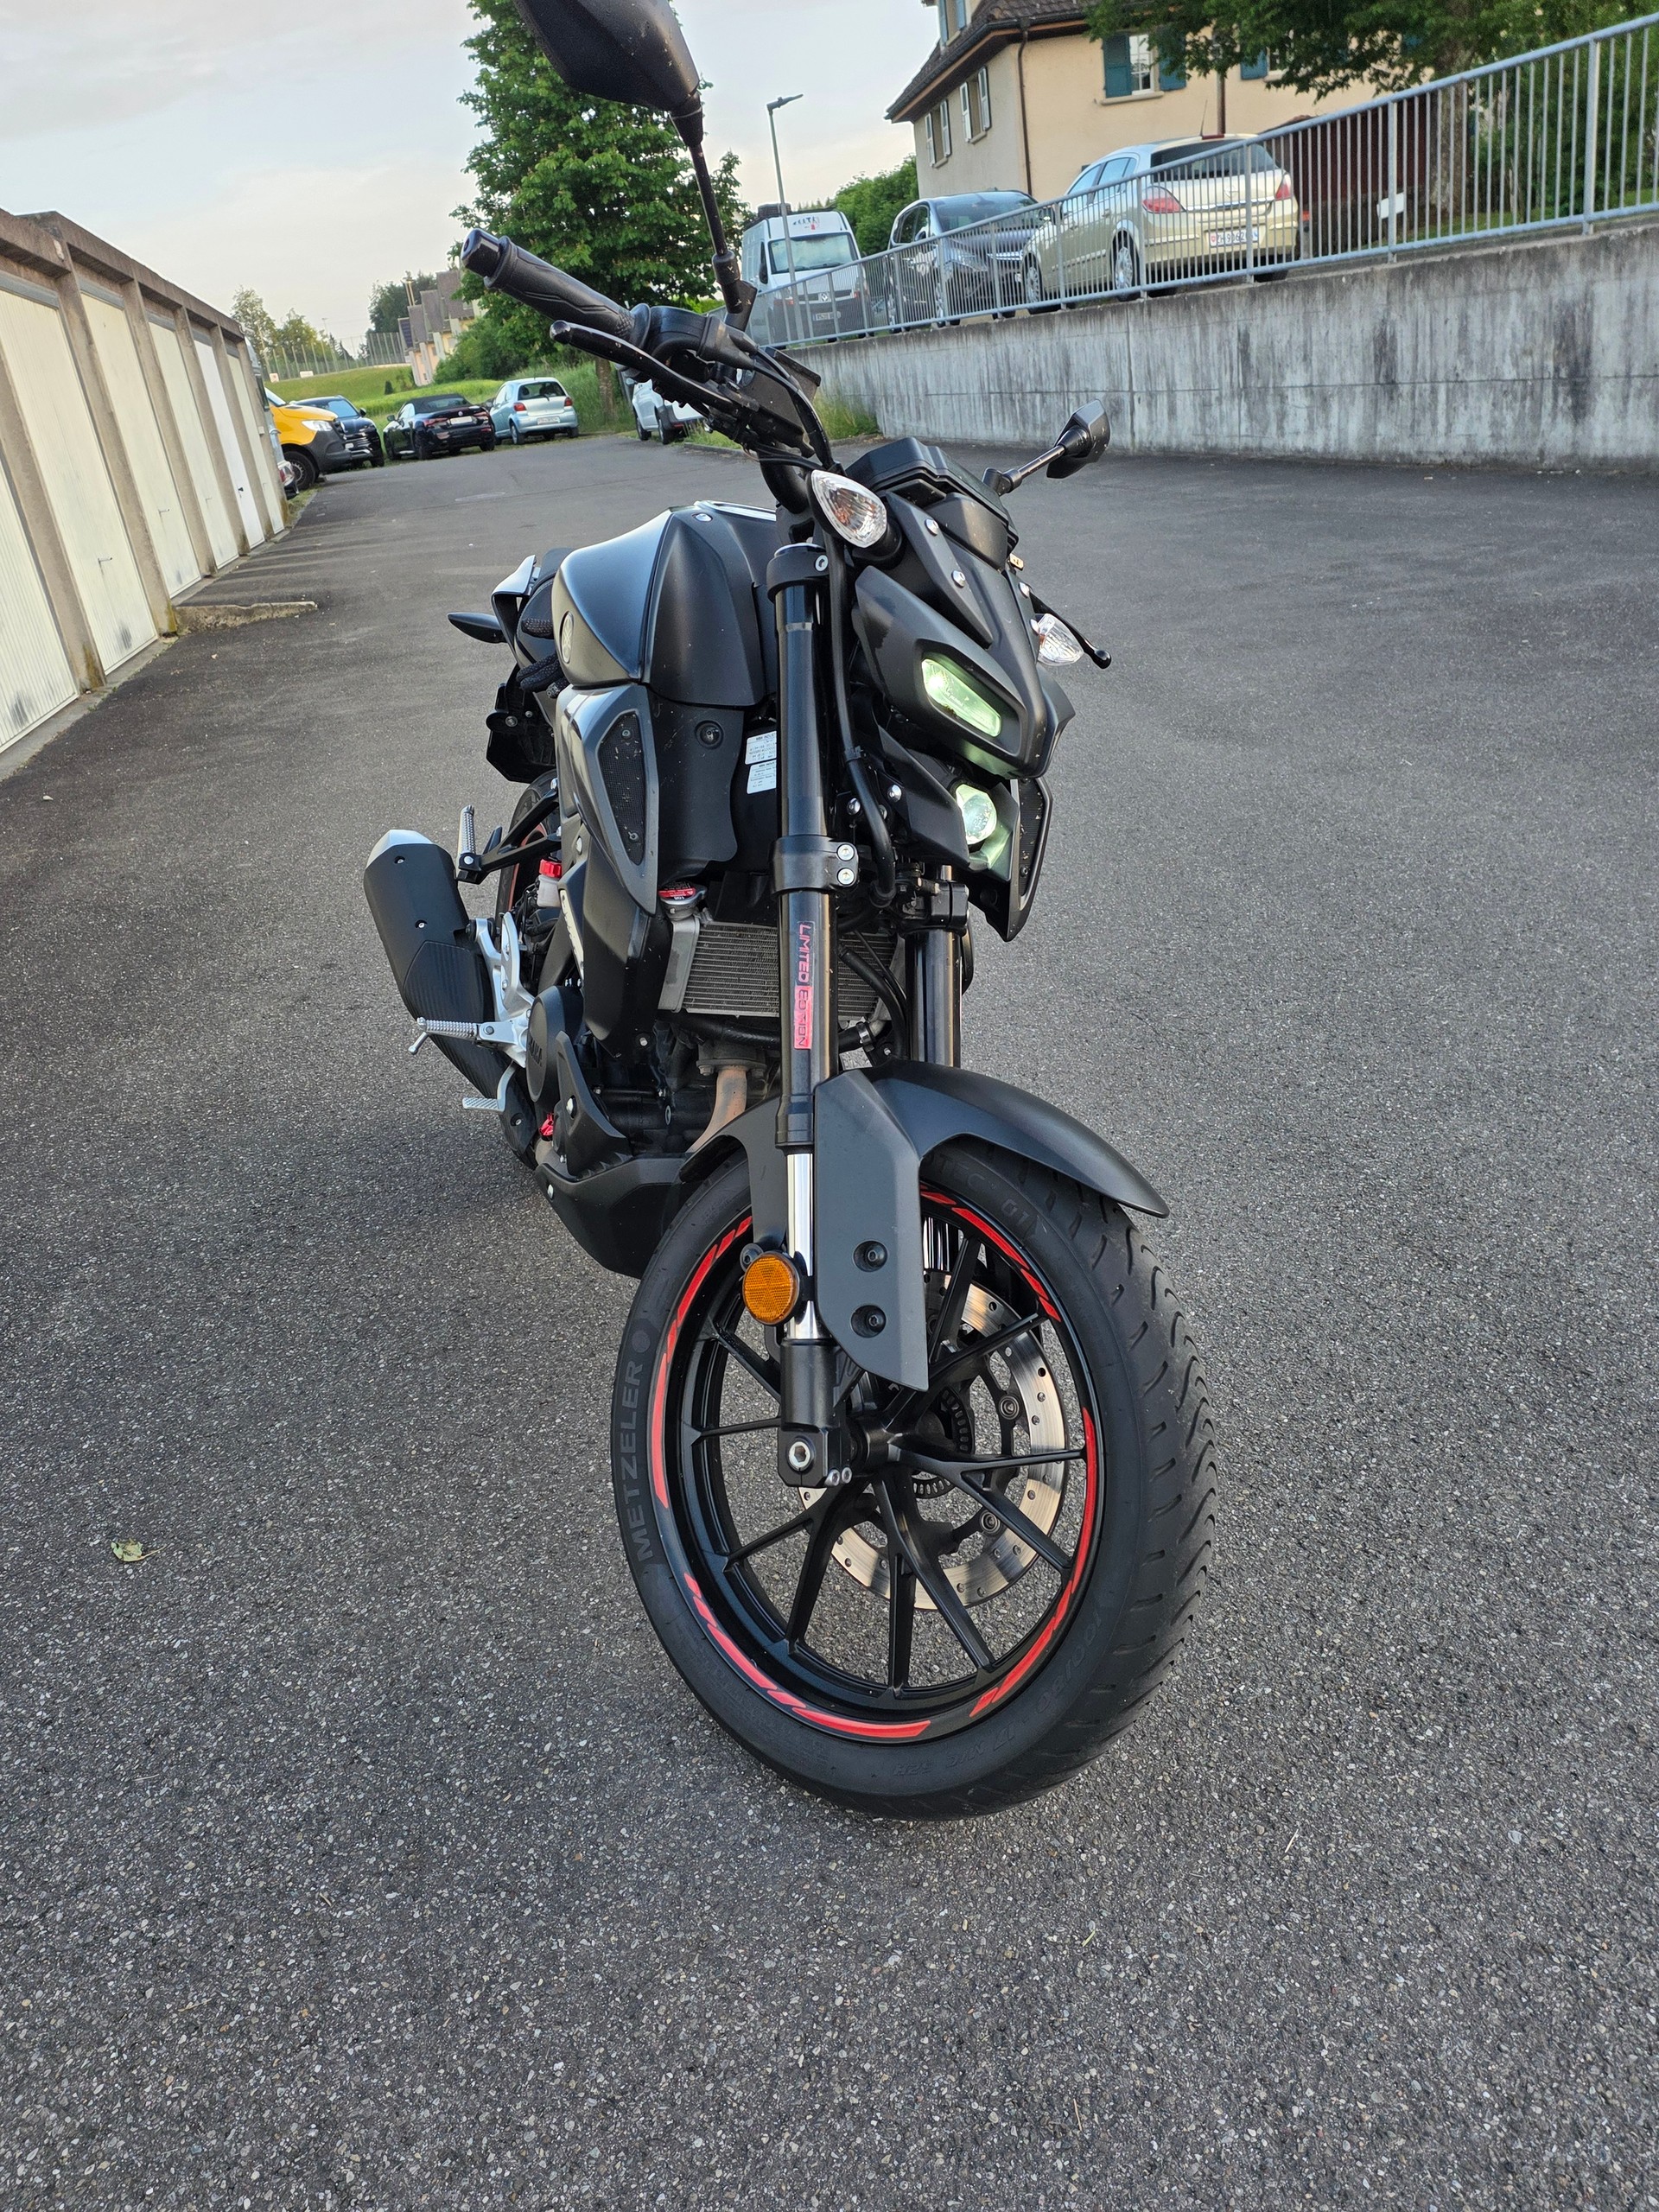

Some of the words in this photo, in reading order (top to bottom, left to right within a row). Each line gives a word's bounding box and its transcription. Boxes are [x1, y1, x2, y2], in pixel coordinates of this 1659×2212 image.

[798, 924, 811, 983] LIMITED
[798, 989, 809, 1047] EDITION
[620, 1360, 653, 1563] METZELER
